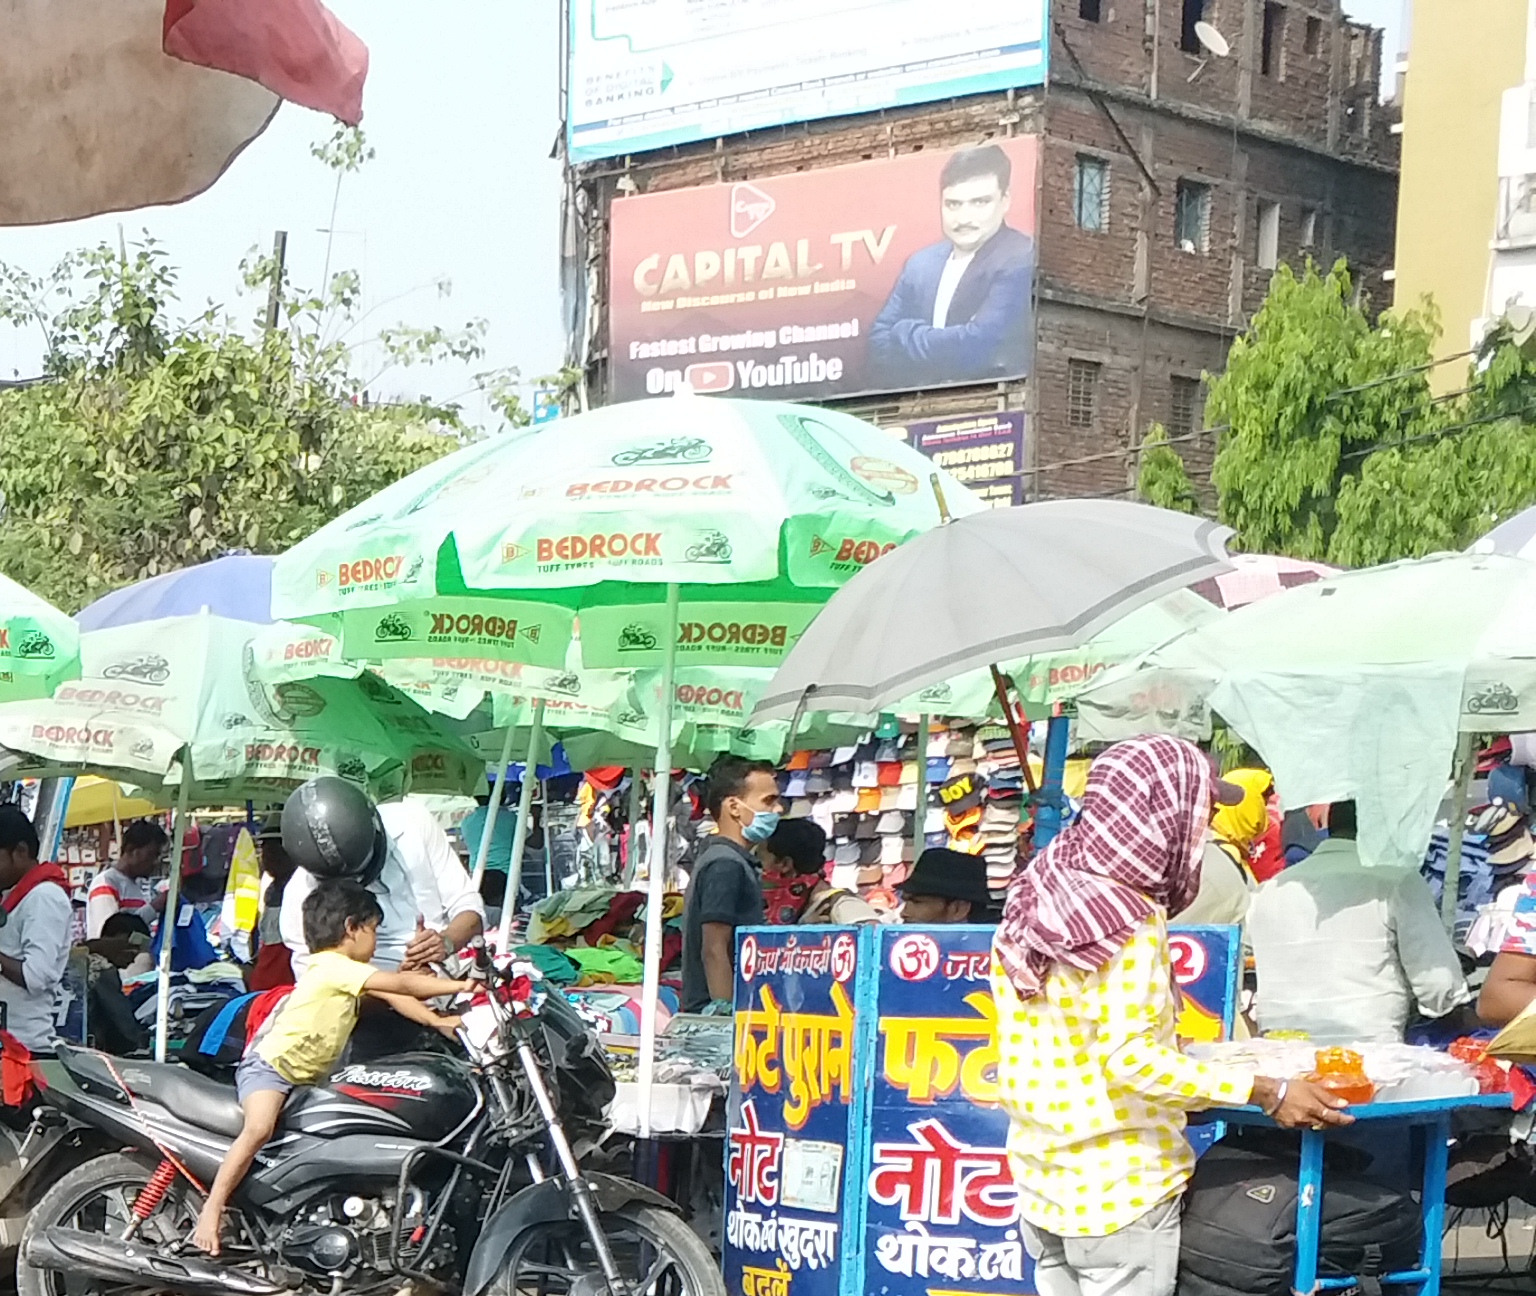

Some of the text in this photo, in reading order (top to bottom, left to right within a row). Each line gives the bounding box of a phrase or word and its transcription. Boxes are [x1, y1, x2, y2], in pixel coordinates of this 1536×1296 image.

[585, 86, 655, 108] BANKING
[633, 225, 898, 297] CAPITAL TV
[641, 278, 856, 313] New Discourse of New India
[629, 317, 859, 361] Fastest Growing Channel
[645, 352, 844, 394] On YouTube
[565, 474, 734, 498] BEDROCK
[536, 532, 663, 562] BEDROCK
[57, 687, 166, 712] BEDROCK
[31, 725, 115, 748] BEDROCK
[245, 743, 322, 766] BEDROCK
[939, 776, 974, 803] BOY
[743, 937, 754, 974] 2
[734, 980, 855, 1129] फटे पुराने
[254, 1154, 275, 1168] ero
[728, 1101, 784, 1206] नोट
[874, 1220, 977, 1280] थोक
